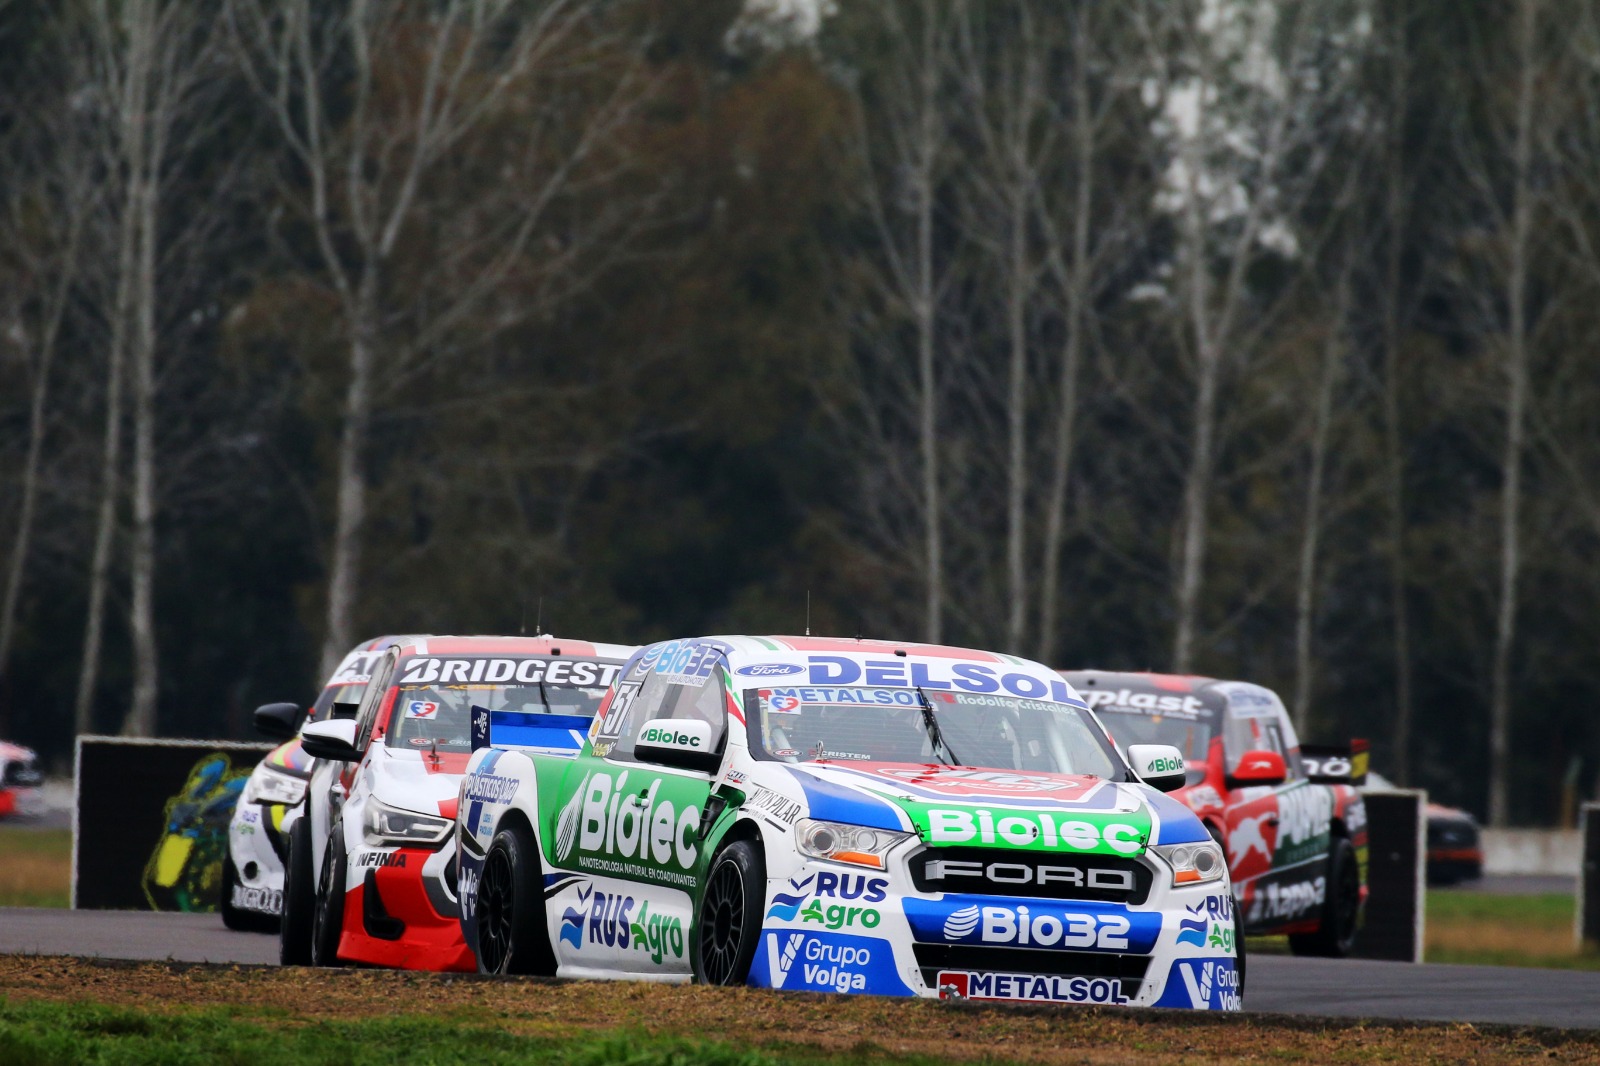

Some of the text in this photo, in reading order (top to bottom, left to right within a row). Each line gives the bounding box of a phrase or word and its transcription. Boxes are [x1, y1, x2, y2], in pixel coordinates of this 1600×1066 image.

[400, 658, 623, 686] BRIDGEST
[654, 639, 722, 678] Bio32
[751, 663, 791, 677] Ford
[807, 655, 1090, 709] DELSOL
[603, 684, 640, 734] 51
[774, 688, 933, 708] METALSOL
[956, 694, 1078, 716] Rodolfo Cristales
[646, 728, 701, 747] Biolec
[821, 750, 871, 760] CRISTEM
[580, 769, 701, 870] Biolec
[765, 796, 802, 825] PILAR
[927, 809, 1141, 853] Biolec
[356, 852, 407, 868] INFINIA
[578, 856, 697, 888] NANOTECNOLOGIA NATURAL EN COADYUVANTES
[928, 859, 1134, 891] FORD
[815, 871, 889, 902] RUS
[589, 891, 684, 965] RUS Agro
[801, 899, 881, 930] Agro
[982, 905, 1130, 949] Bio32
[805, 938, 871, 967] Grupo
[804, 963, 866, 993] Volga
[969, 972, 1127, 1004] METALSOL
